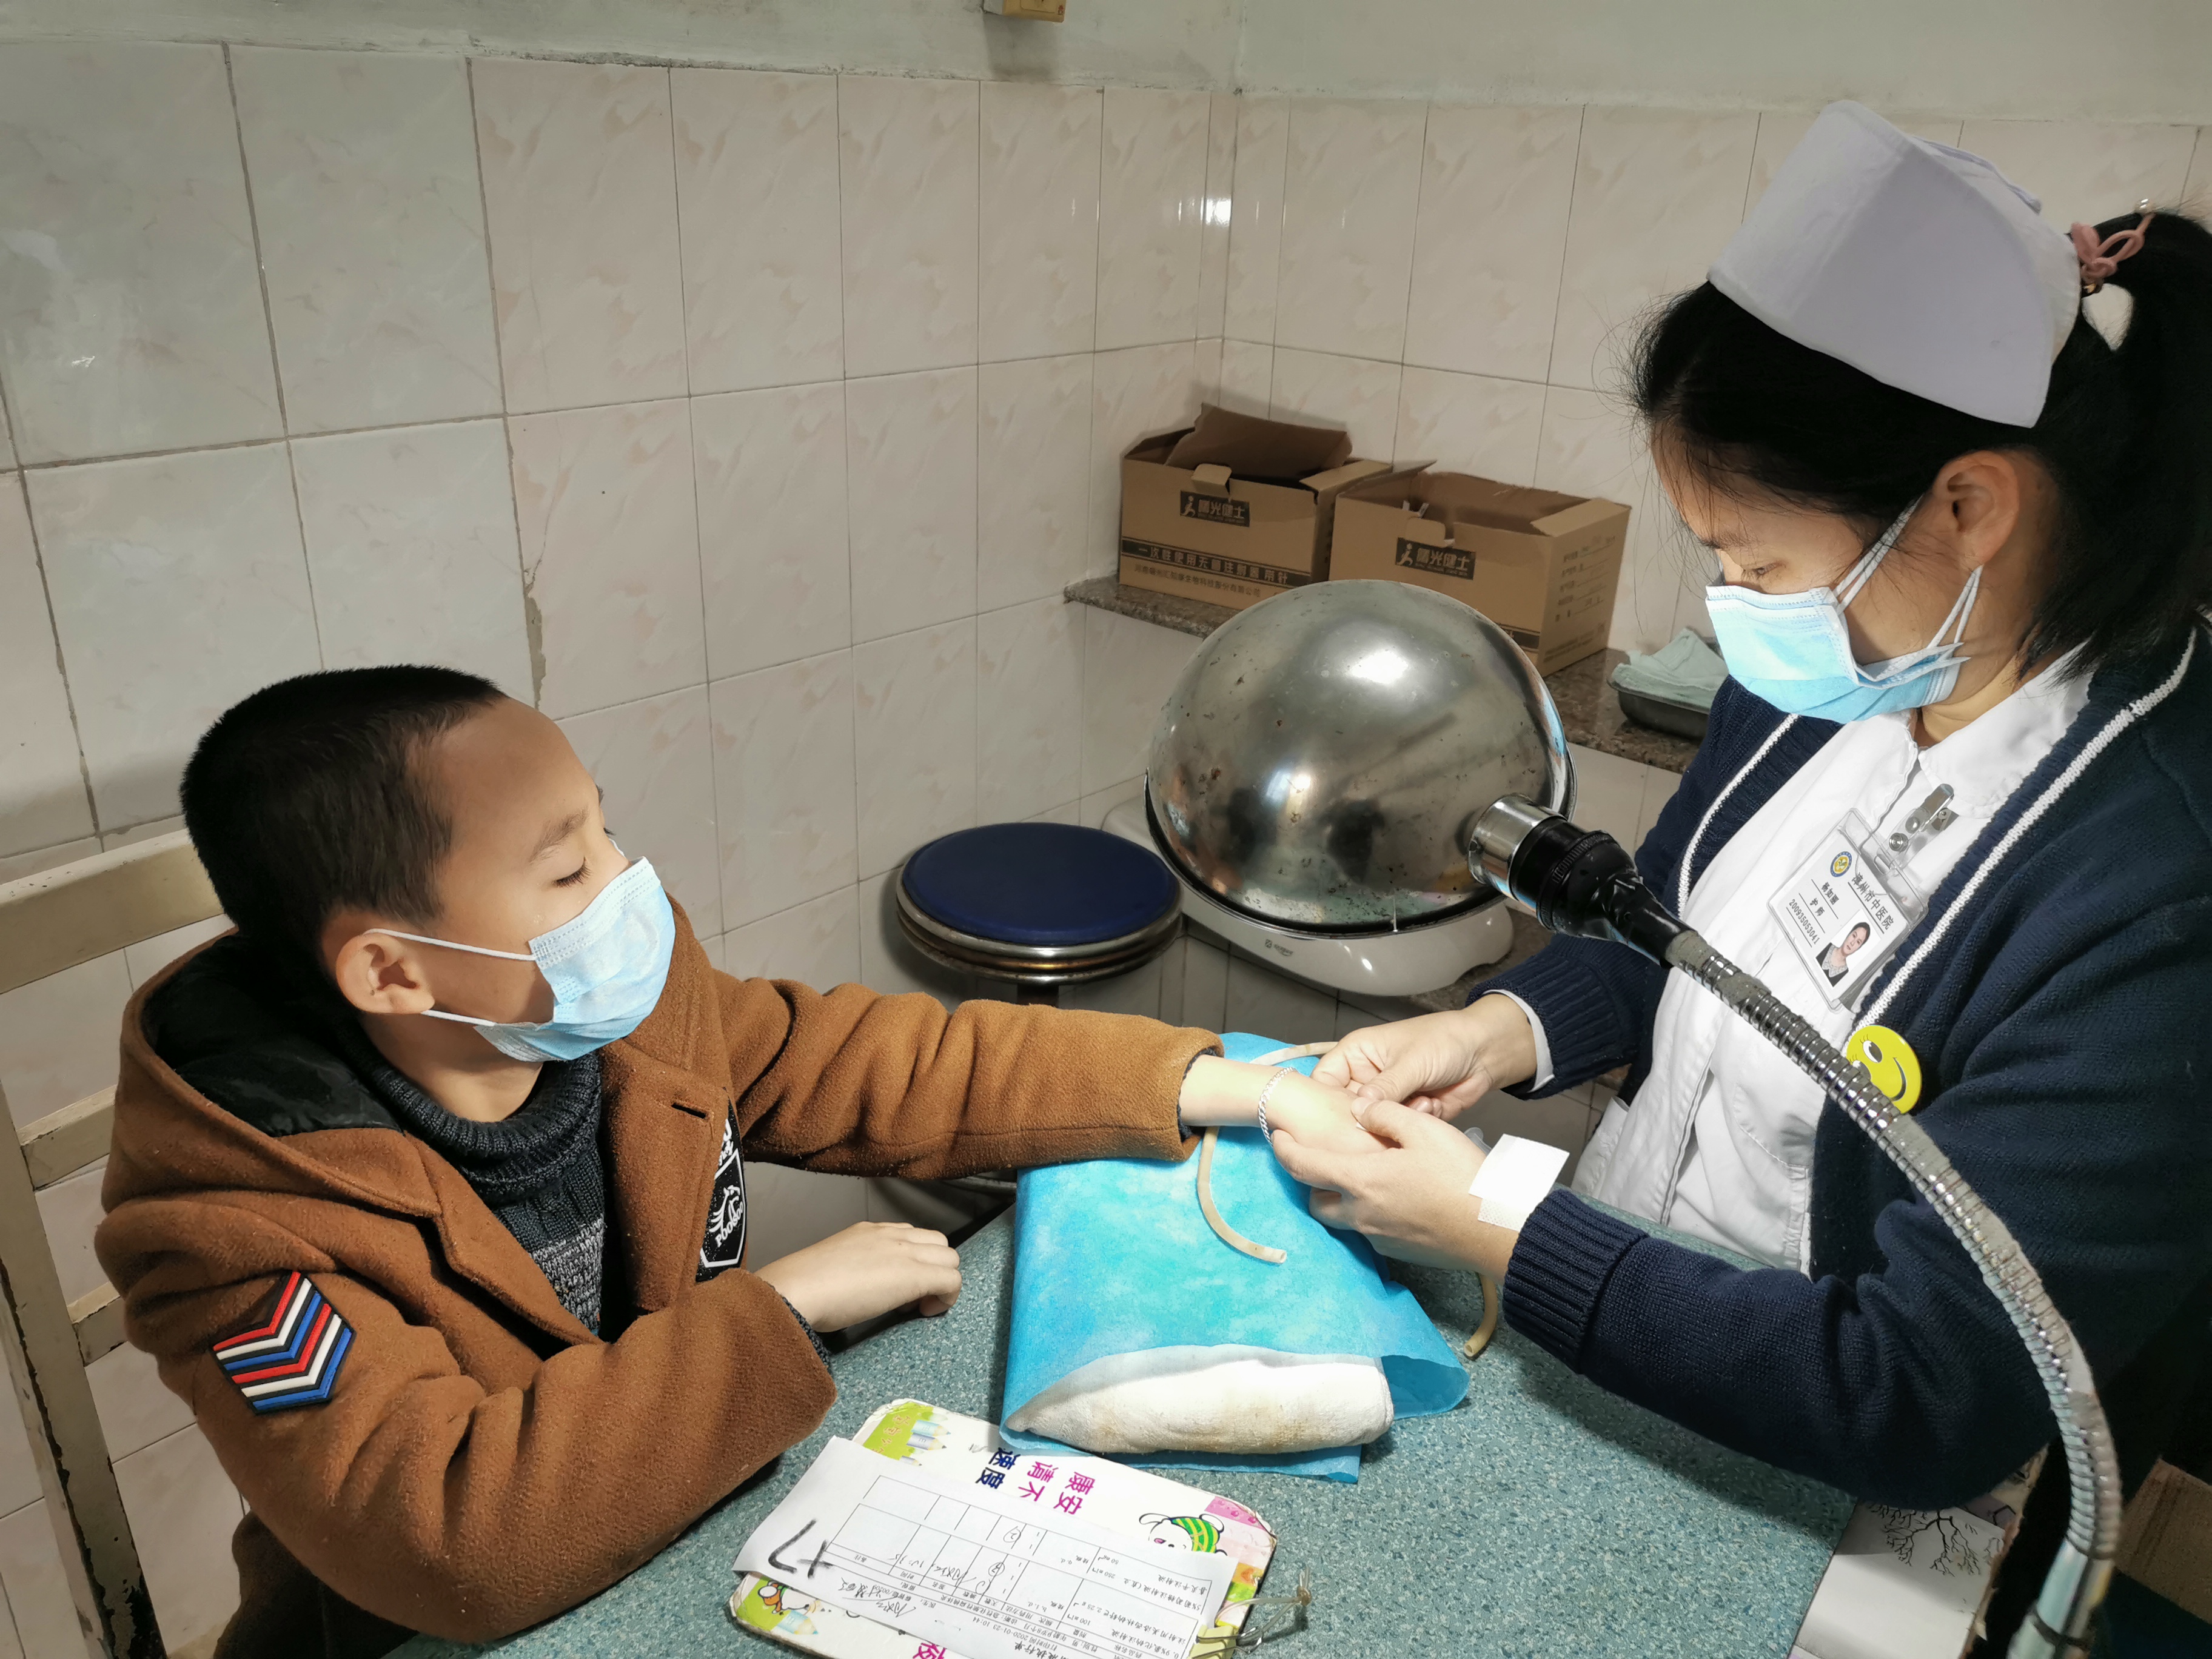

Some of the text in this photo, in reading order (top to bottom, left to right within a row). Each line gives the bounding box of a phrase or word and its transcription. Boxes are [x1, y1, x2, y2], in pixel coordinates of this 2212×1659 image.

[1821, 882, 1840, 905] 杨如丽
[1851, 872, 1894, 930] 漳州市中医院
[1788, 899, 1820, 945] 200935053041
[973, 1617, 990, 1627] 10:44
[993, 1624, 1028, 1641] 2020-01-23
[1012, 1640, 1068, 1659] 液执行单
